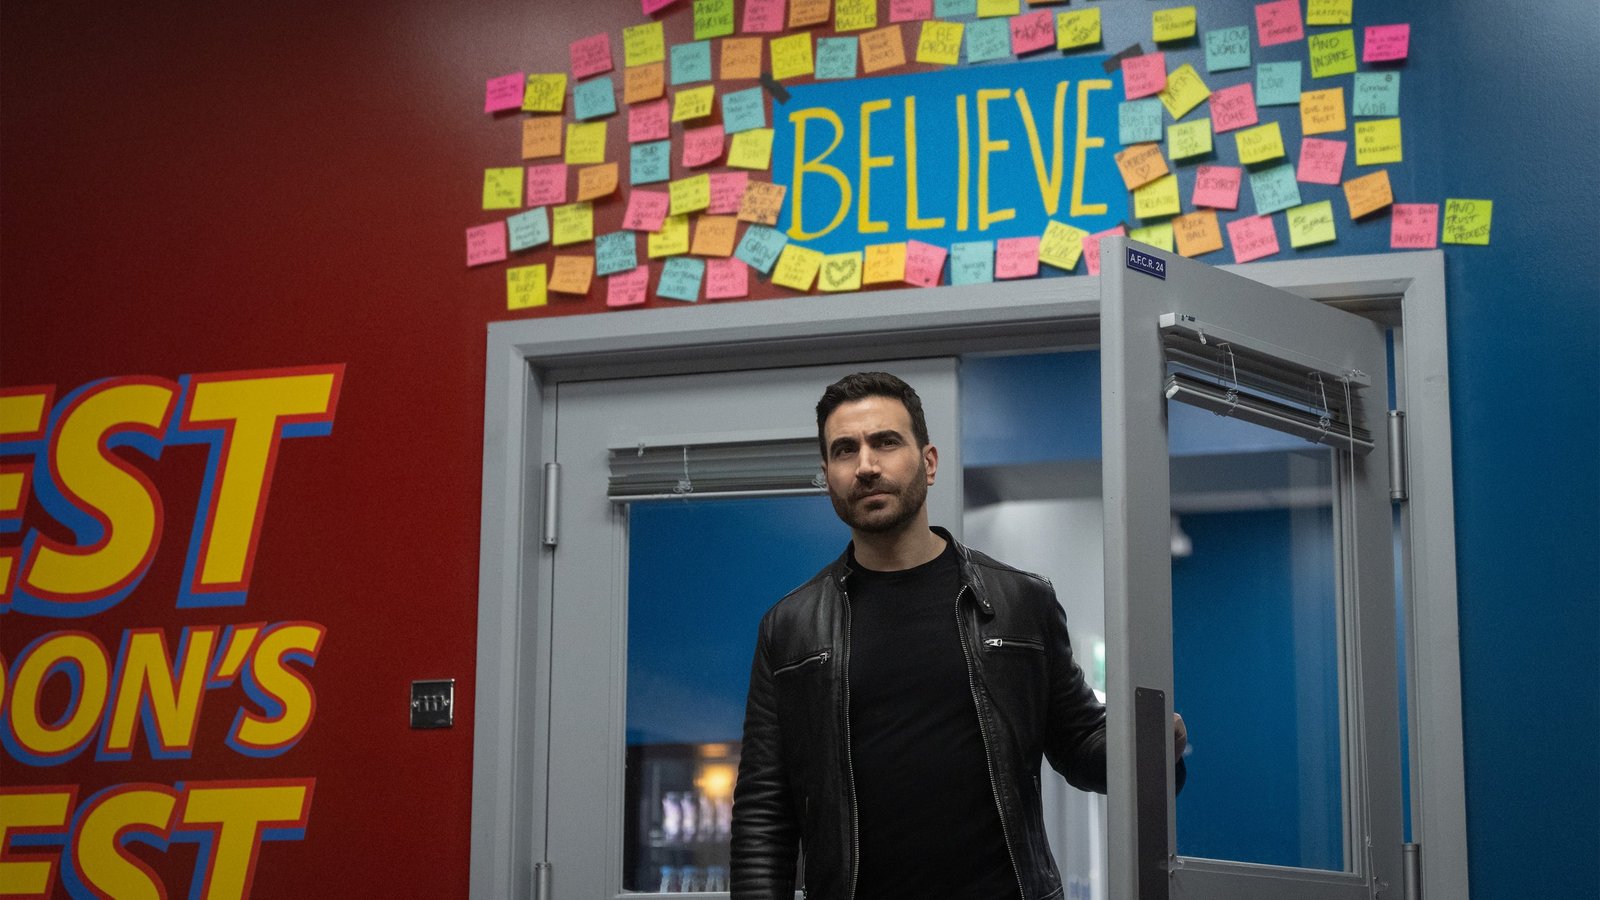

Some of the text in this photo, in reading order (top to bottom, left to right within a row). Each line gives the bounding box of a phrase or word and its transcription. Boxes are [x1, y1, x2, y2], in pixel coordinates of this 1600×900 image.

[697, 1, 726, 14] AND
[1312, 36, 1340, 50] AND
[1216, 111, 1245, 126] COME
[786, 79, 1113, 241] BELIEVE
[1449, 201, 1477, 214] AND
[1445, 213, 1478, 227] TRUST
[1047, 225, 1079, 242] AND
[1130, 254, 1164, 272] A.F.C.R. 24
[0, 620, 327, 767] ON'S
